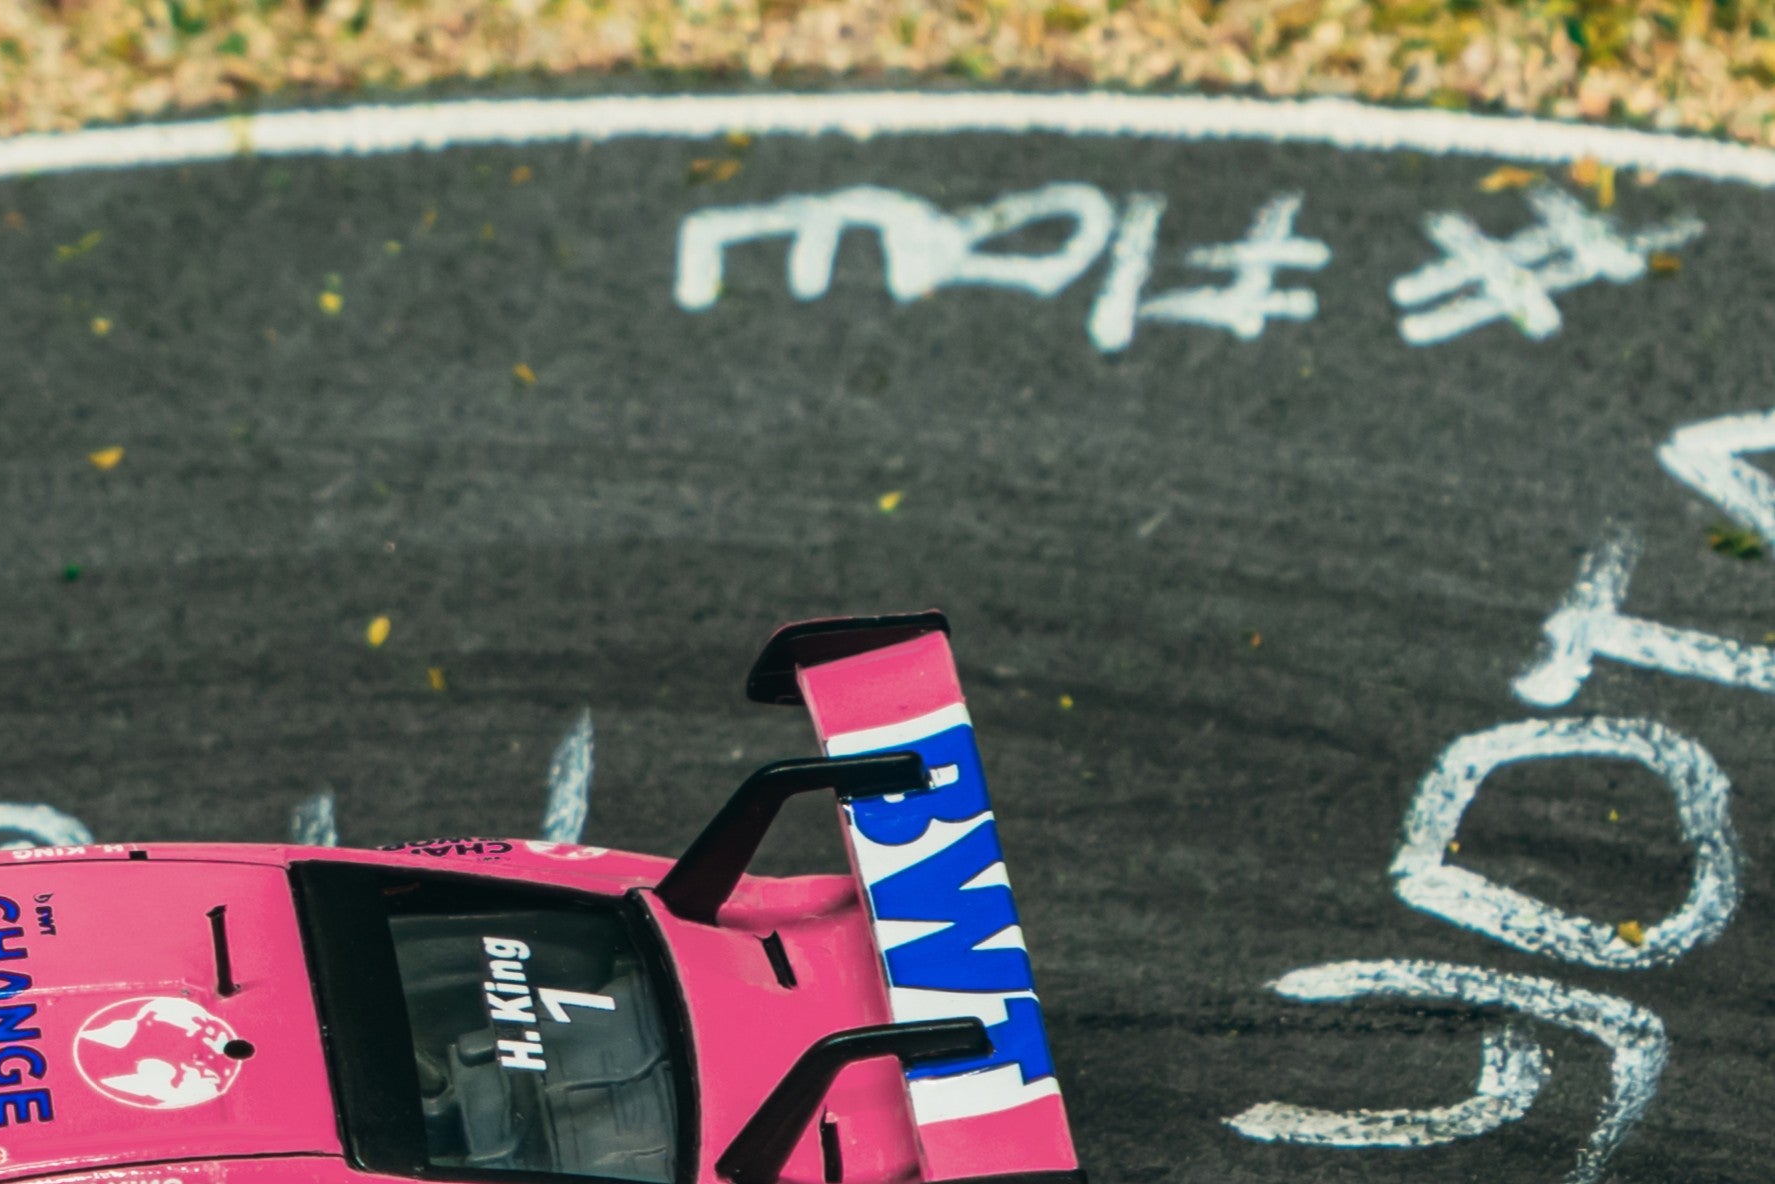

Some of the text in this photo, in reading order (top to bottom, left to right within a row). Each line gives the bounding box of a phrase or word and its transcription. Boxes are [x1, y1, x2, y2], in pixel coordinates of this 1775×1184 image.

[850, 723, 1056, 1086] BWT
[482, 936, 548, 1071] H. King
[536, 986, 616, 1024] 1
